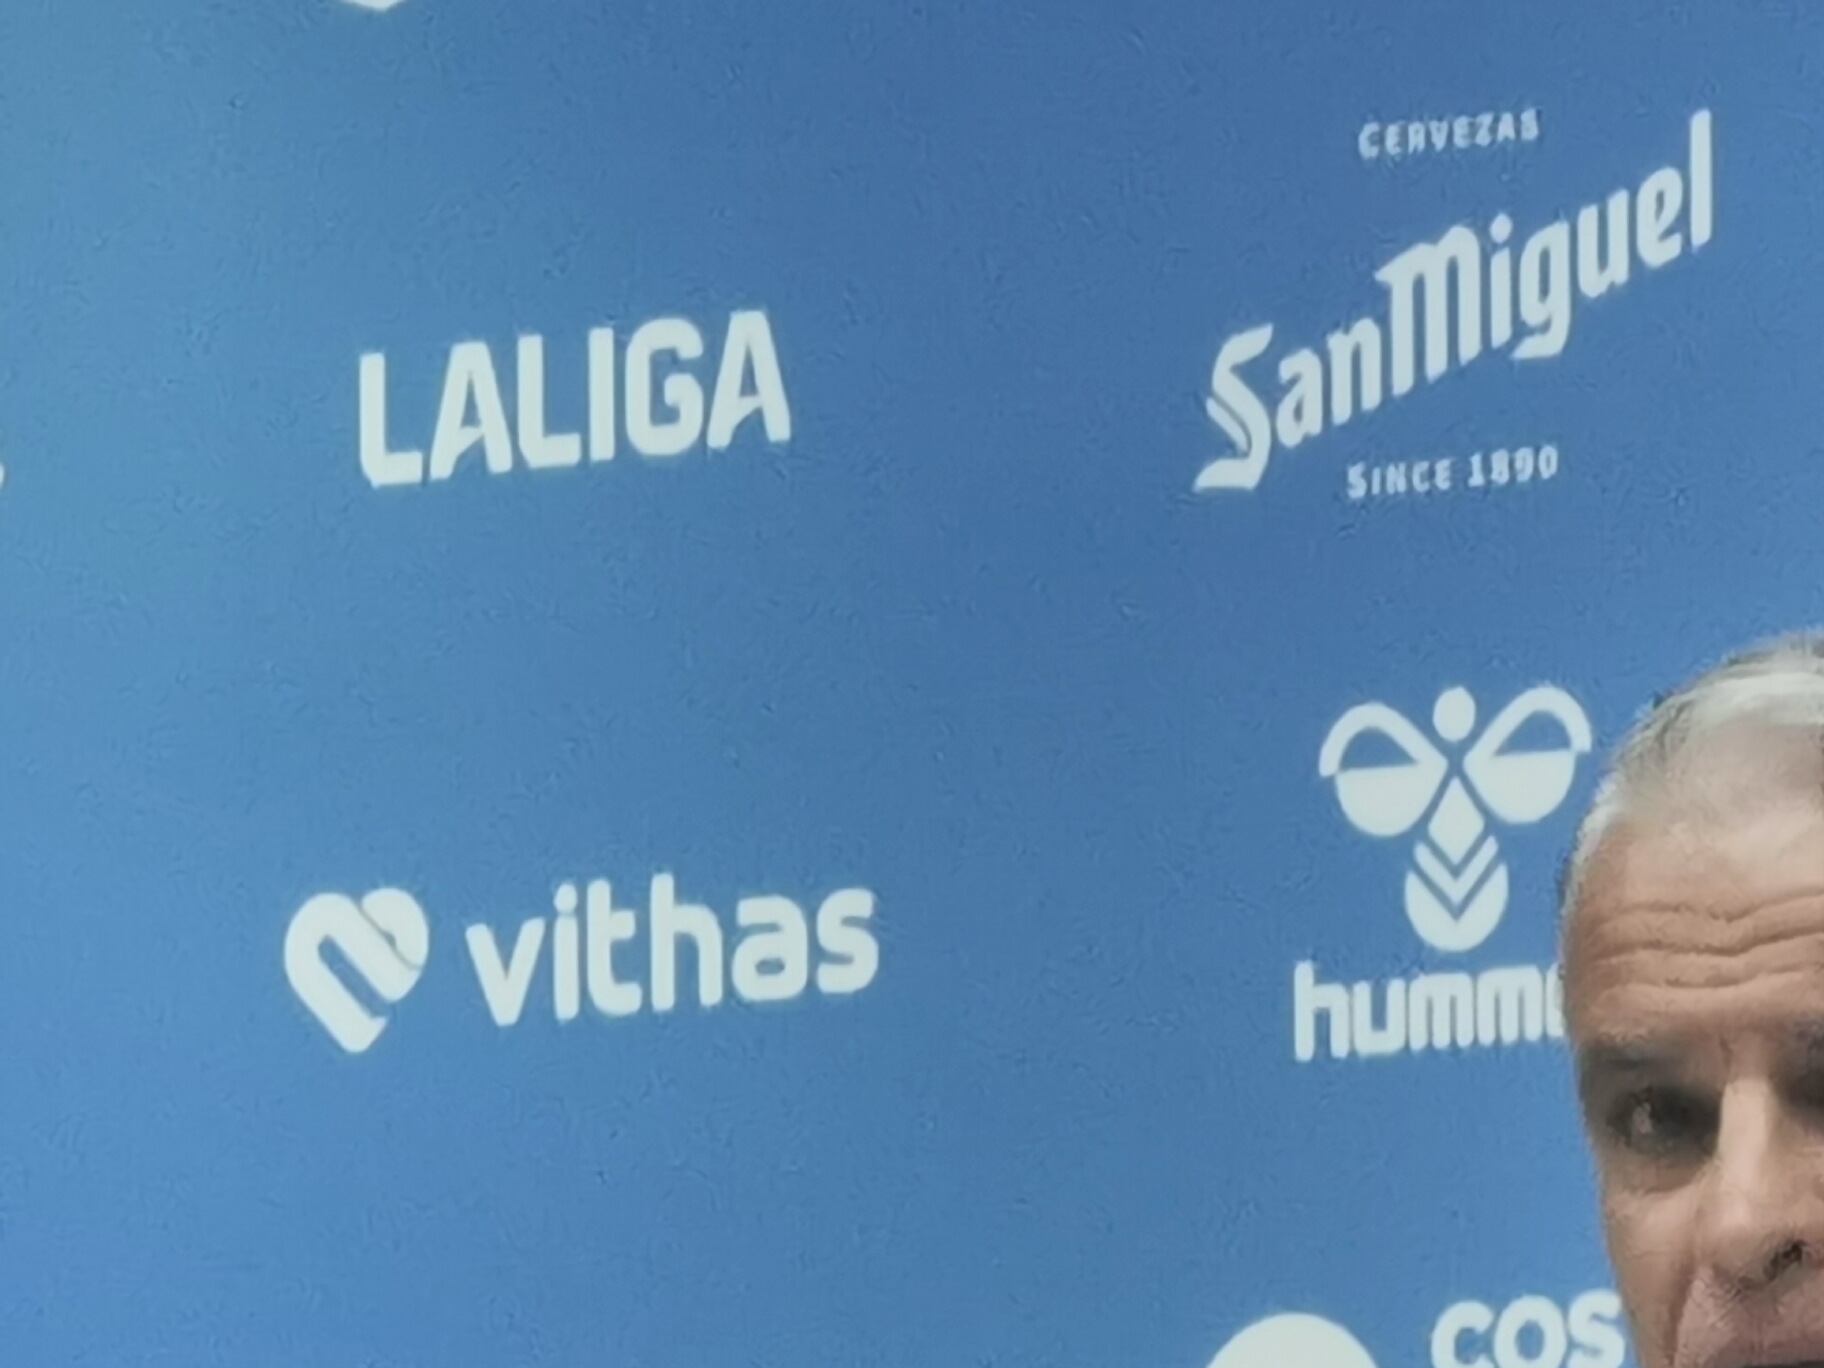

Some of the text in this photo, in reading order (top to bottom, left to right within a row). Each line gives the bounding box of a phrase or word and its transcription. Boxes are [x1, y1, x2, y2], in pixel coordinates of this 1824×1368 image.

[1357, 107, 1541, 161] CERVEZAS
[359, 310, 791, 488] LALIGA
[1346, 445, 1559, 500] SINCE 1890
[464, 872, 880, 1027] vithas
[1294, 959, 1565, 1063] humm
